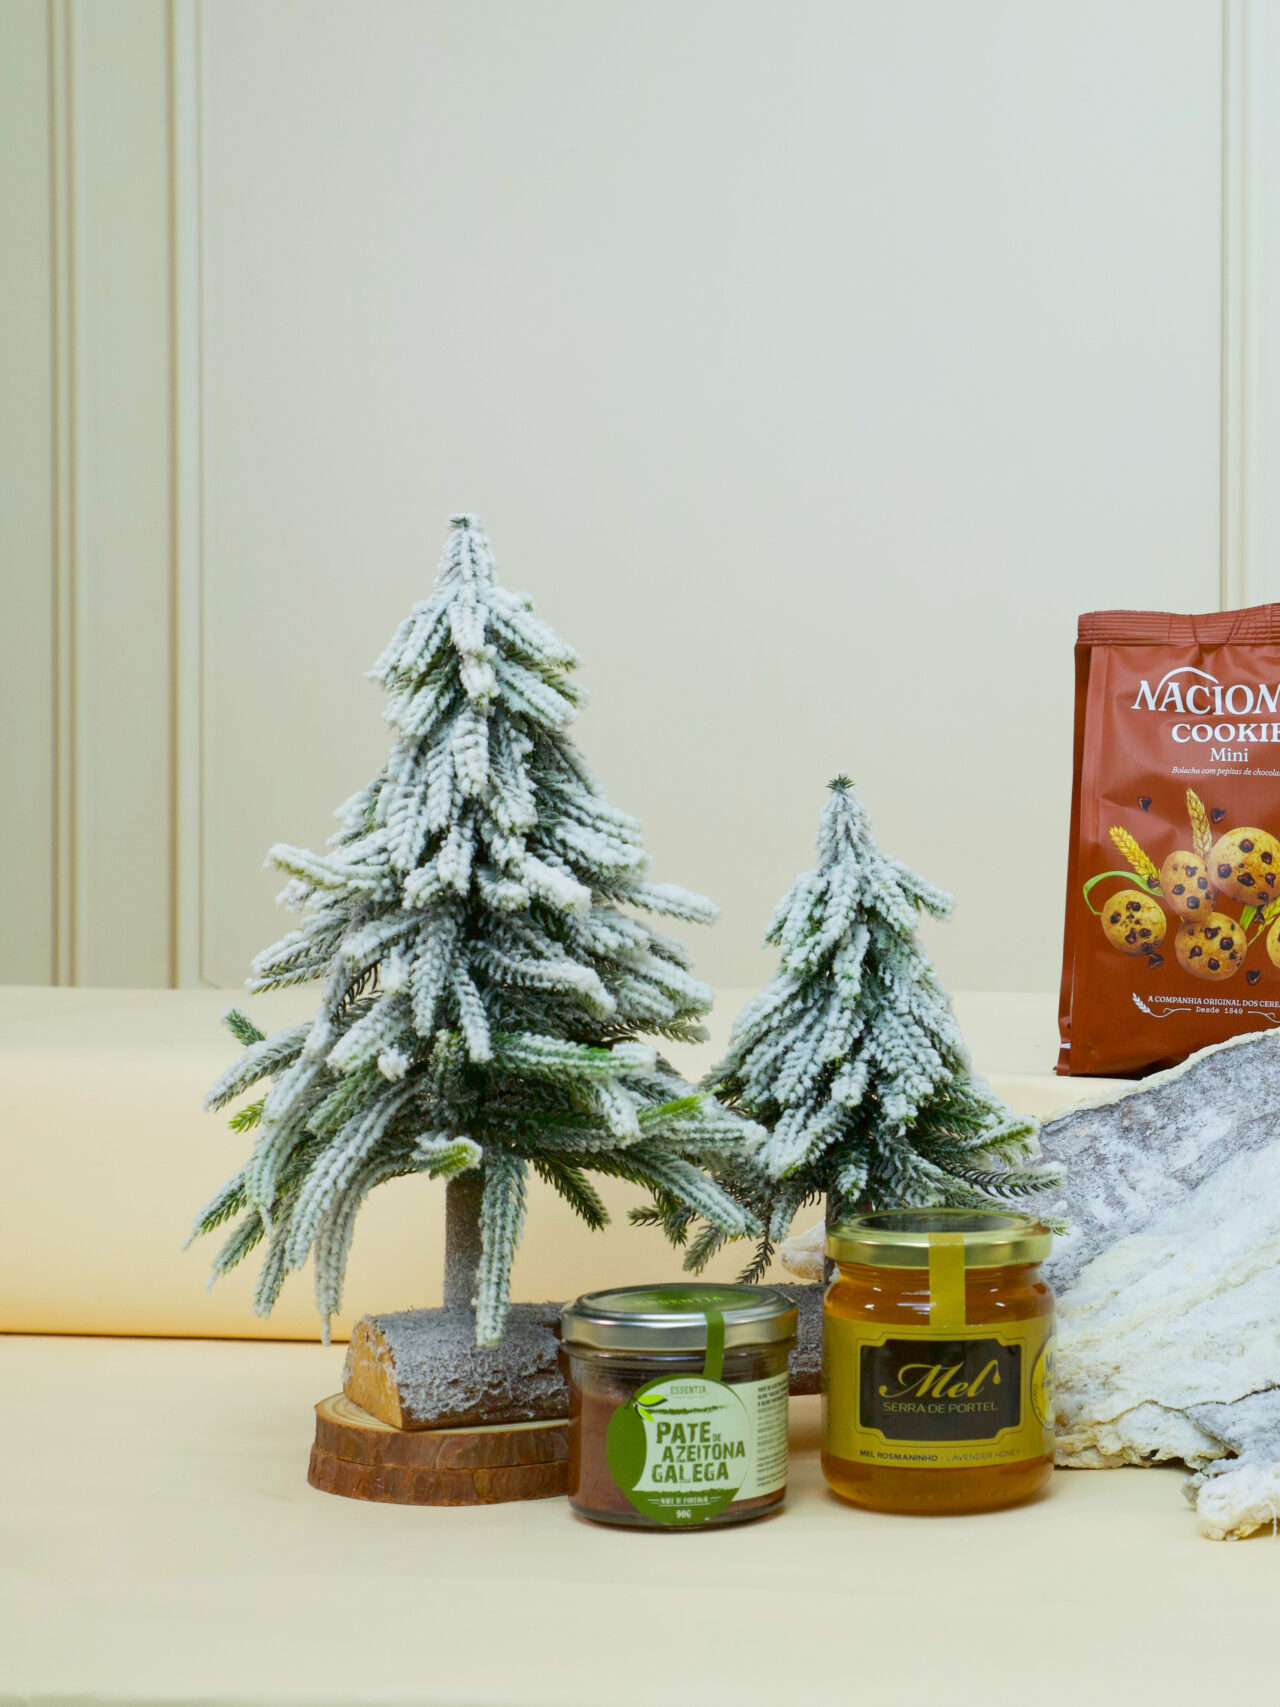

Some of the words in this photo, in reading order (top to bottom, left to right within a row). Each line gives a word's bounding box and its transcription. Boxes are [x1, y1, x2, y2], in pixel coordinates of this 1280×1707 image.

[1209, 747, 1249, 763] Mini
[1171, 766, 1200, 774] Bolacha
[1216, 768, 1242, 777] pepitas
[1243, 768, 1252, 776] de
[1154, 996, 1203, 1005] COMPANHIA
[1203, 998, 1241, 1007] ORIGINAL
[1196, 1006, 1220, 1014] Desde
[878, 1359, 1001, 1398] Mel
[883, 1402, 930, 1413] SERRA
[931, 1403, 946, 1414] DE
[948, 1401, 998, 1414] PORTEL
[656, 1421, 711, 1444] PATE
[713, 1433, 722, 1441] DE
[662, 1440, 746, 1463] AZEITONA
[859, 1449, 875, 1458] MEL
[877, 1451, 938, 1462] ROSMANINHO
[946, 1453, 994, 1462] LAVENDER
[652, 1461, 729, 1484] GALEGA
